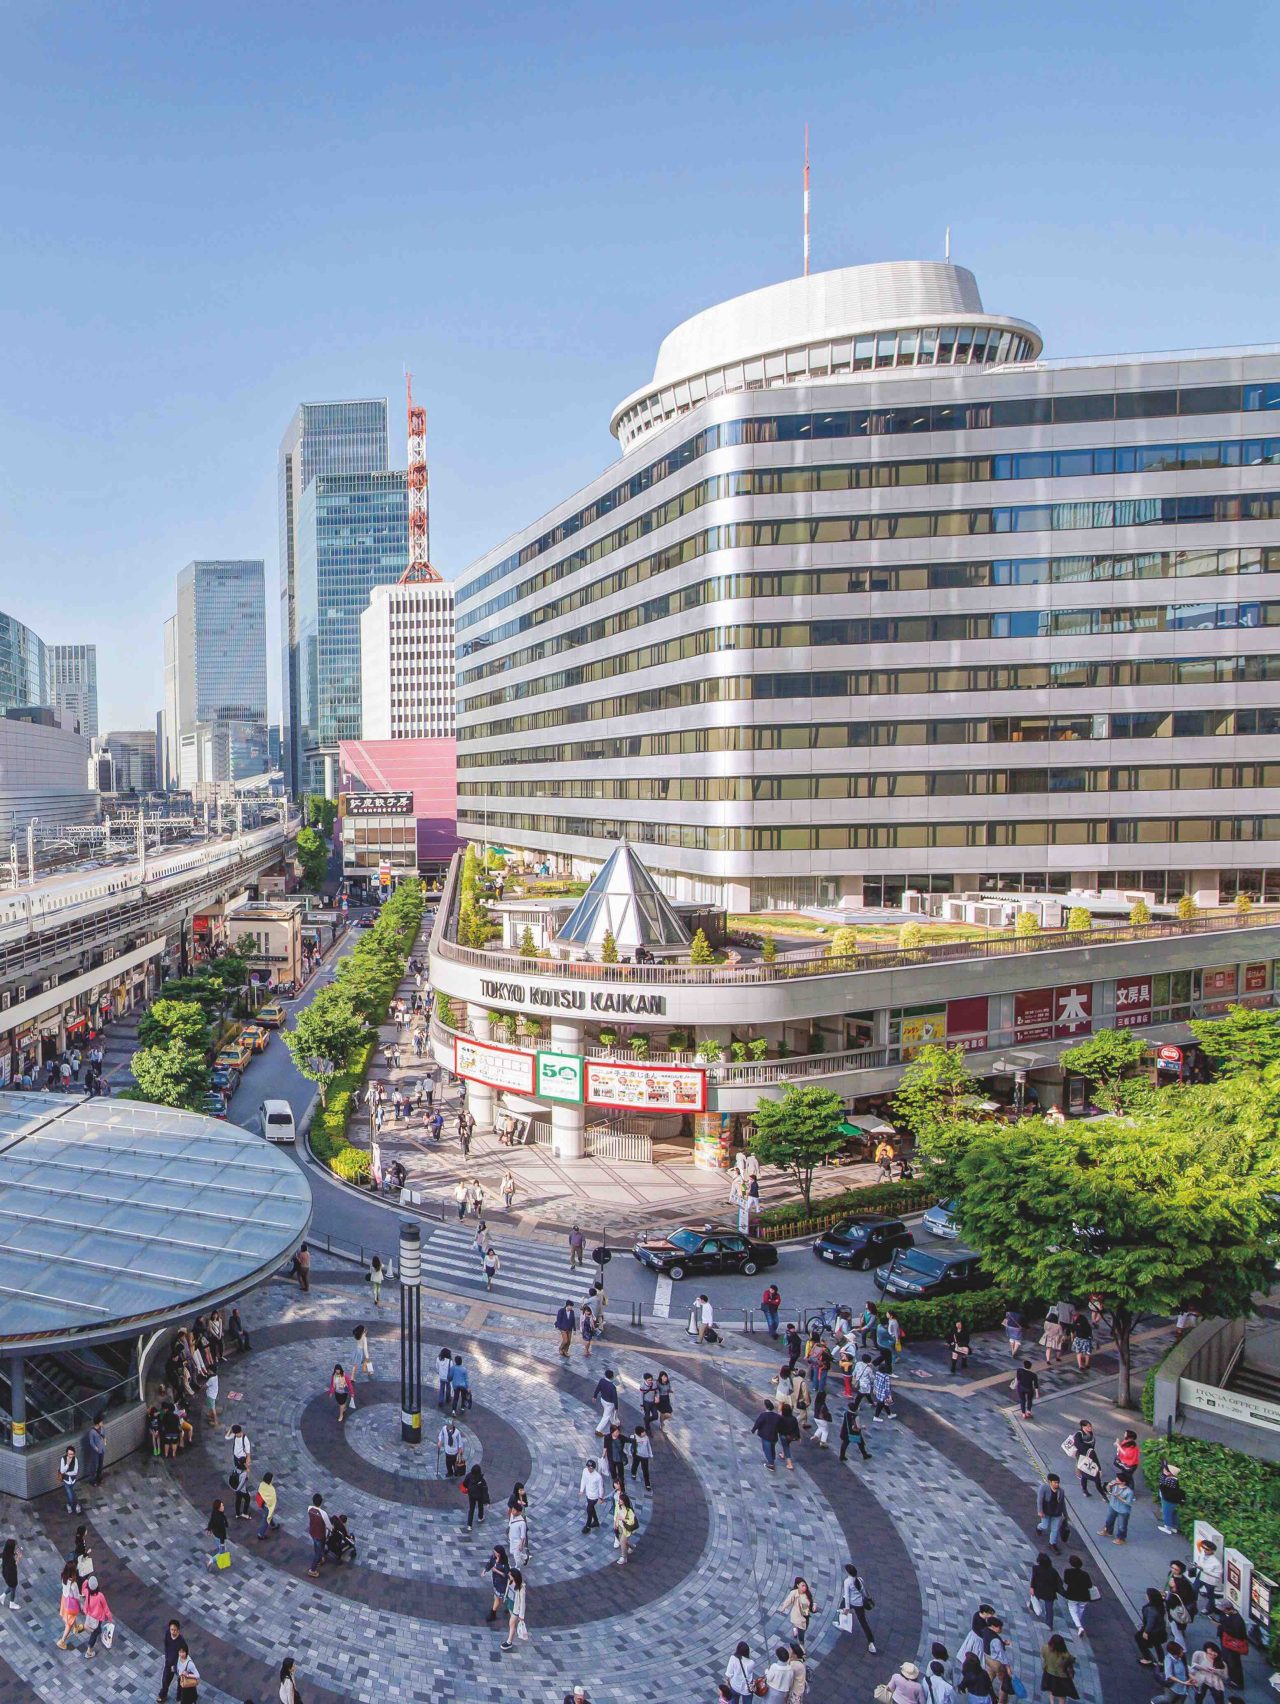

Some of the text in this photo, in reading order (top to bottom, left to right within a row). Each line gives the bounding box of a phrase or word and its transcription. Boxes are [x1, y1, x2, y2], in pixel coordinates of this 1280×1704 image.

[480, 978, 667, 1016] TOKYO KOTSU KAIKAN
[1058, 988, 1090, 1033] 本
[1116, 984, 1150, 1006] 文房具
